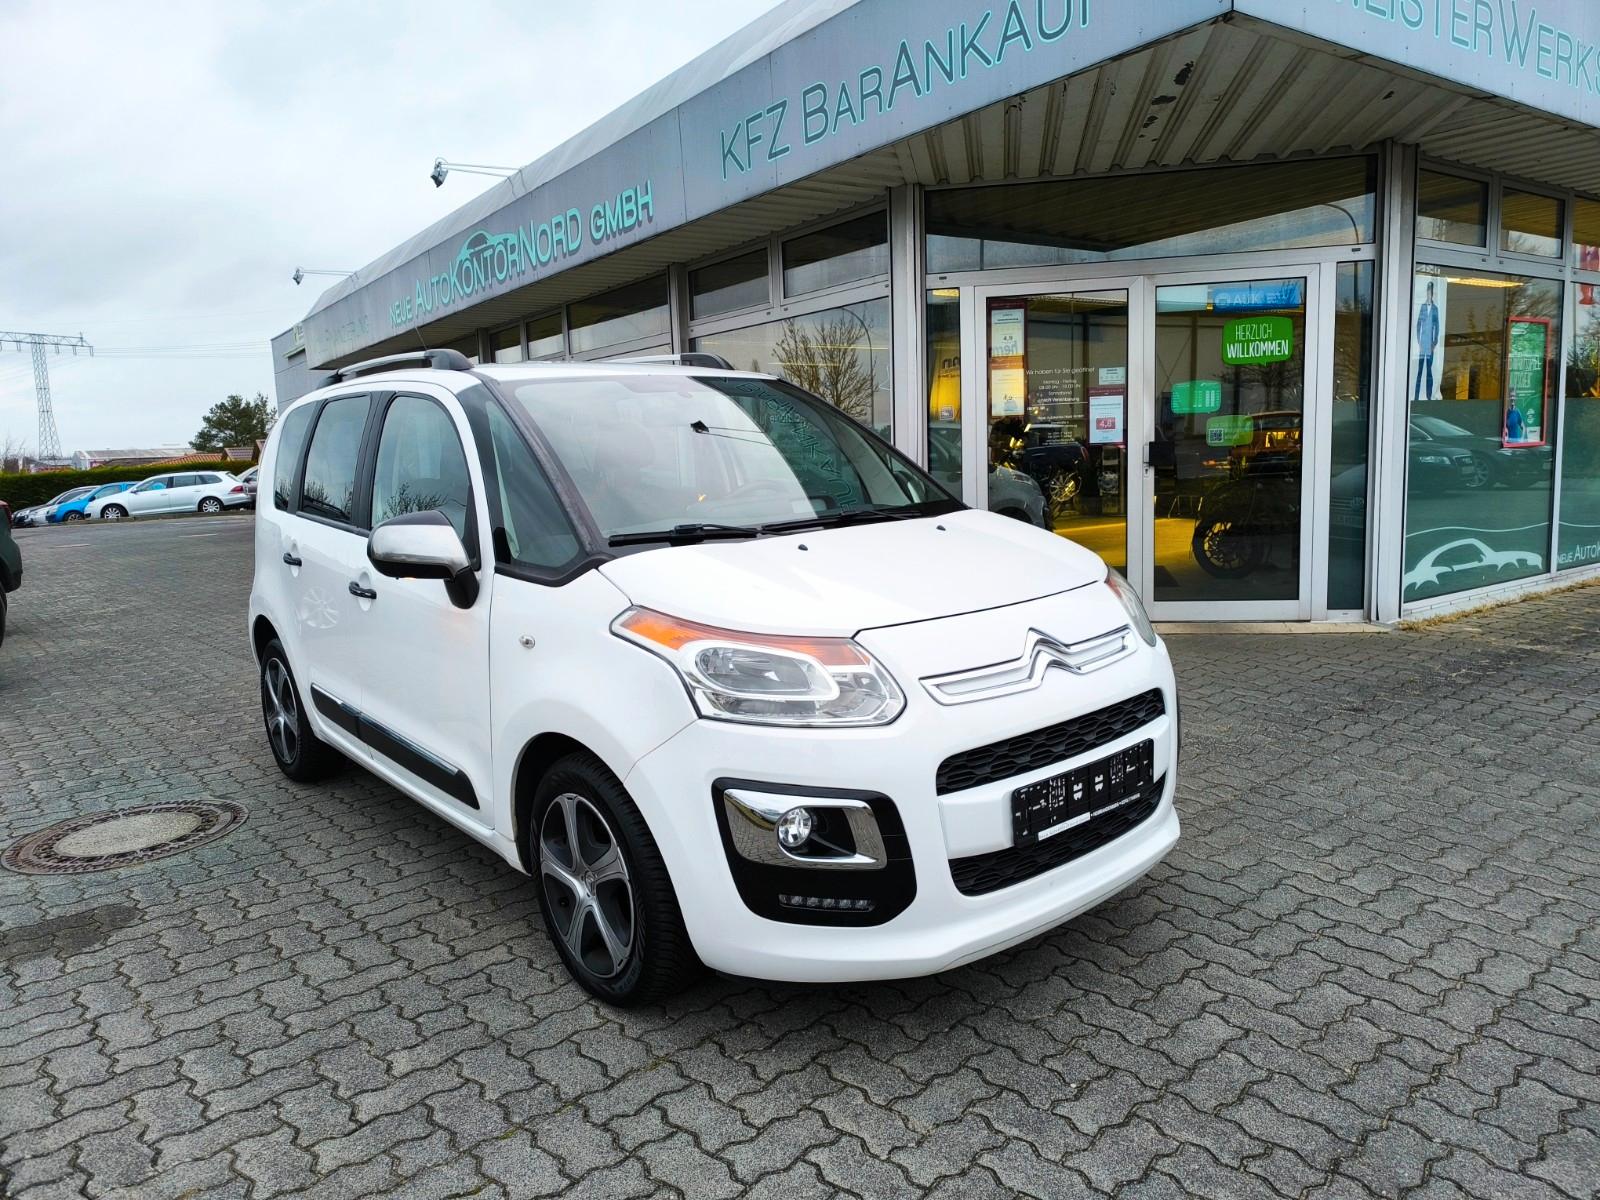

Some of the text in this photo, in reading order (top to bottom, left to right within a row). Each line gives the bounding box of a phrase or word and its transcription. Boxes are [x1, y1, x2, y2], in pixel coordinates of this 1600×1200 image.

[720, 99, 790, 180] KFZ
[390, 296, 412, 328] NEUE
[590, 180, 653, 241] GMBH
[1227, 339, 1288, 358] WILLKOMMEN
[1235, 323, 1272, 340] HERZLICH
